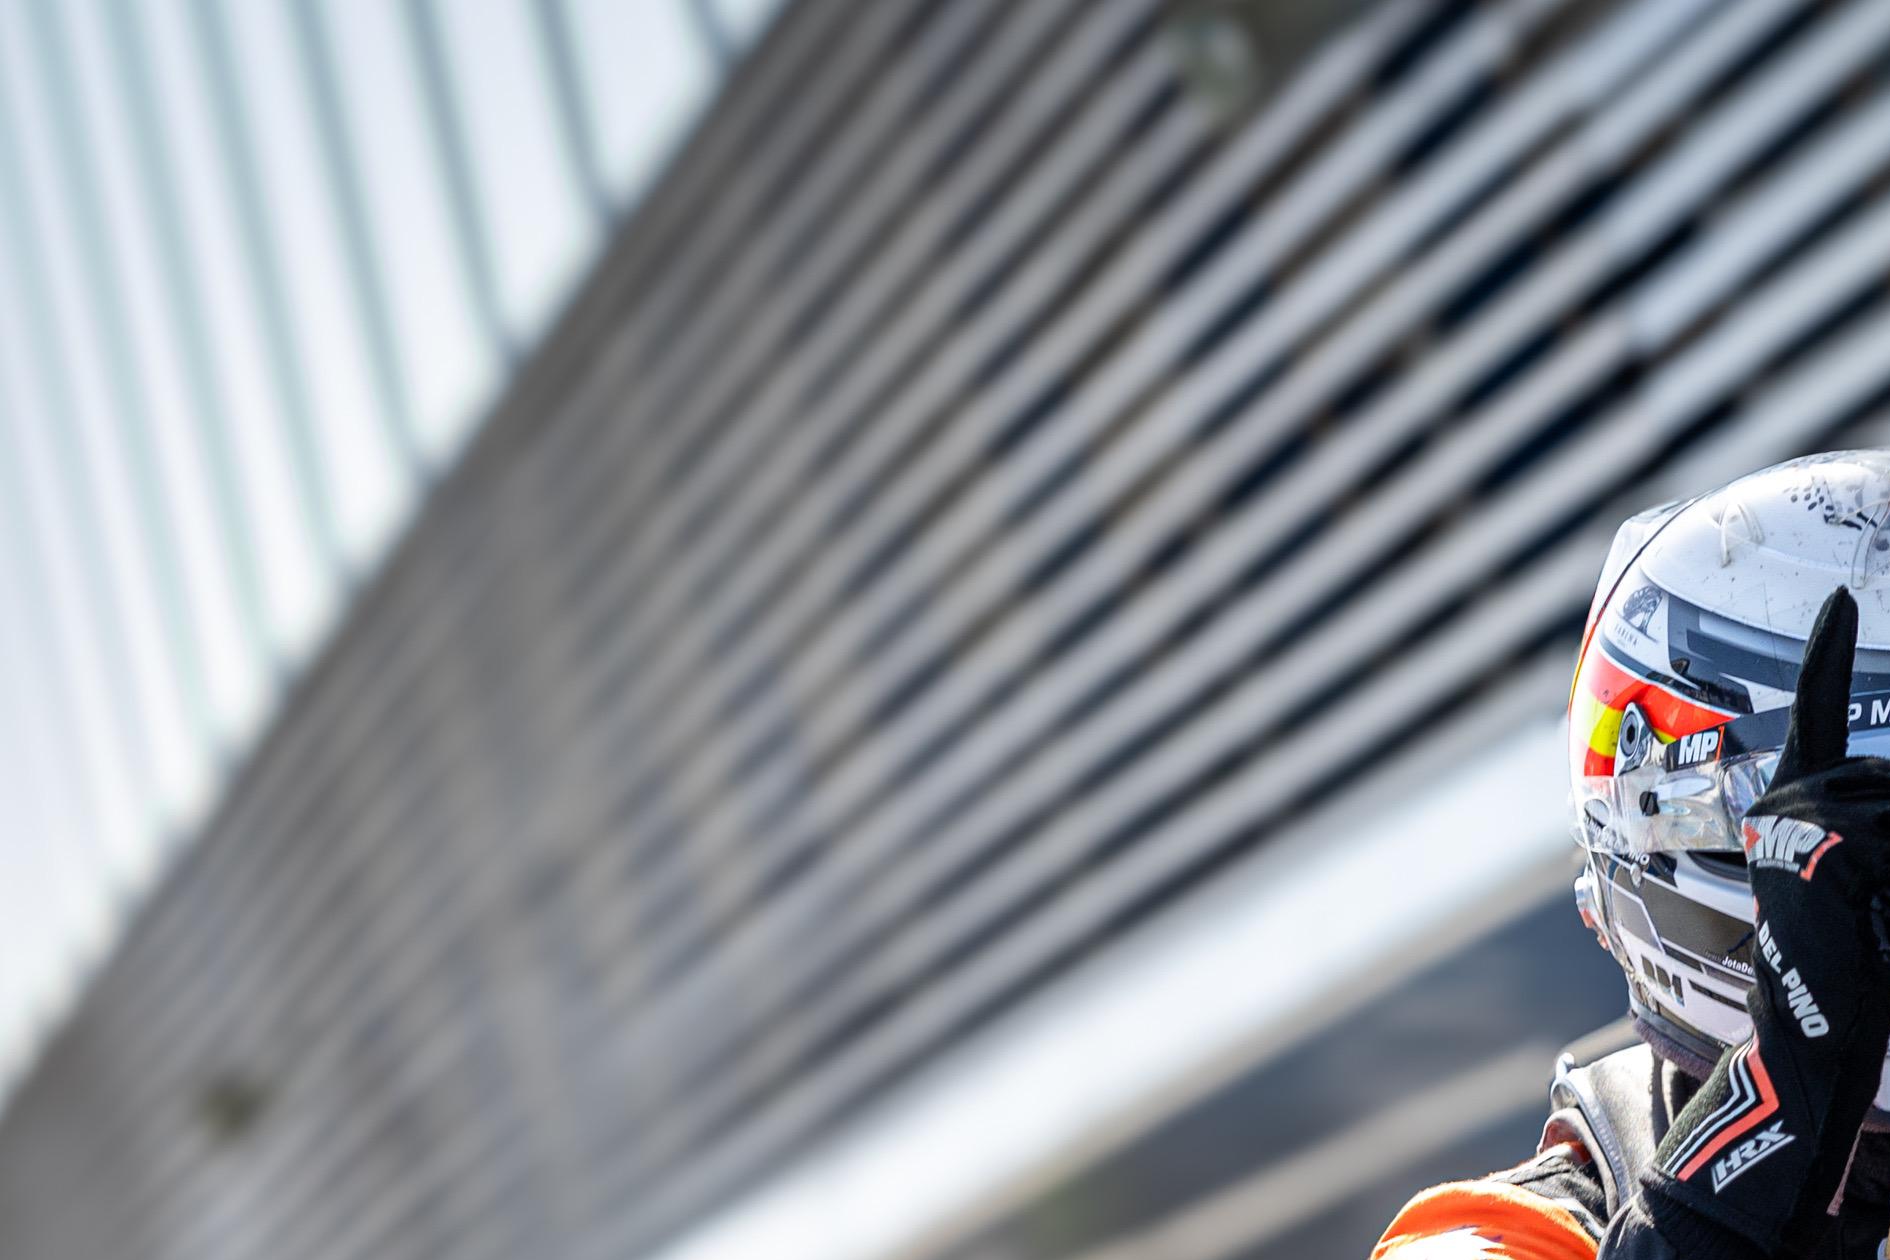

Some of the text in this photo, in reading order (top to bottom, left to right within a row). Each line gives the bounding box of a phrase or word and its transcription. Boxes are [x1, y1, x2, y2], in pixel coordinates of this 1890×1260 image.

[1678, 731, 1719, 765] MP
[1758, 920, 1829, 1038] DEL PINO
[1714, 1119, 1785, 1178] HRX
